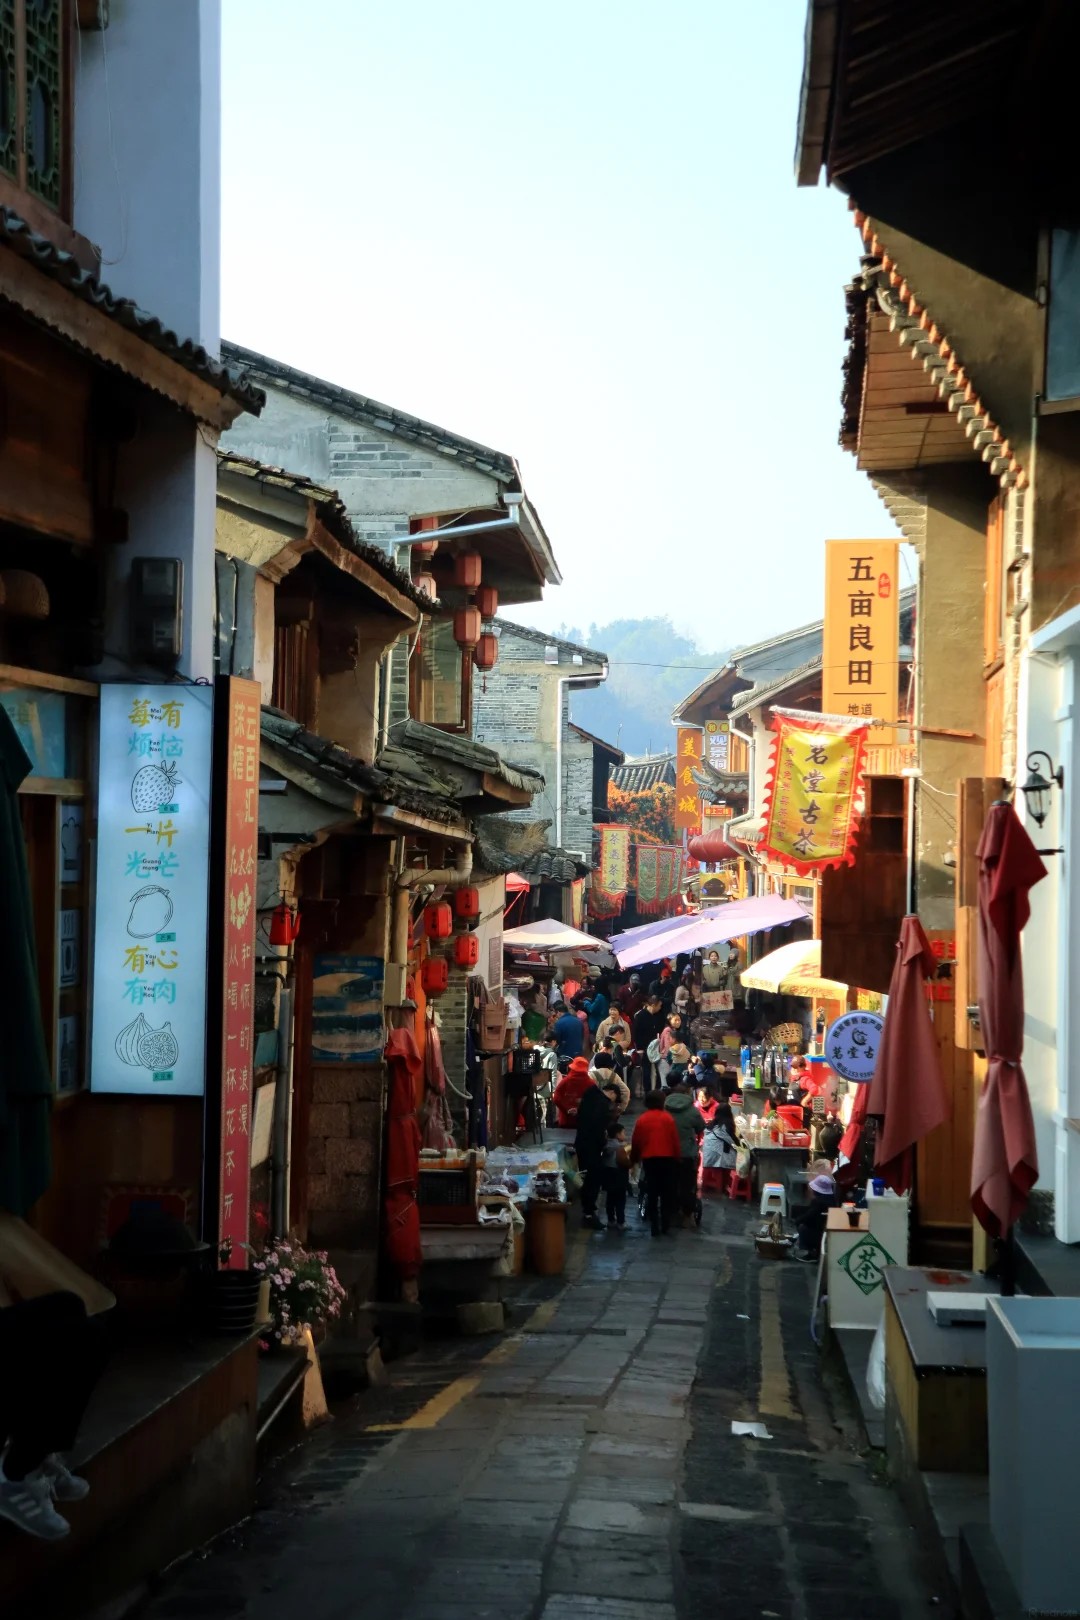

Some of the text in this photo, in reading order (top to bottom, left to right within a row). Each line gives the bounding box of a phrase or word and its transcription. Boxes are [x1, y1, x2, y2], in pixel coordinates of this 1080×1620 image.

[847, 556, 875, 685] 五亩良田
[847, 703, 873, 716] 地道
[128, 732, 184, 758] 烦恼
[679, 736, 699, 816] 美食城
[792, 744, 829, 855] 茗堂古茶
[125, 820, 178, 847] 一片
[125, 851, 179, 878] 光芒
[123, 945, 178, 974] 有心
[122, 977, 176, 1005] 有肉
[239, 944, 251, 1135] 和顺的浪漫
